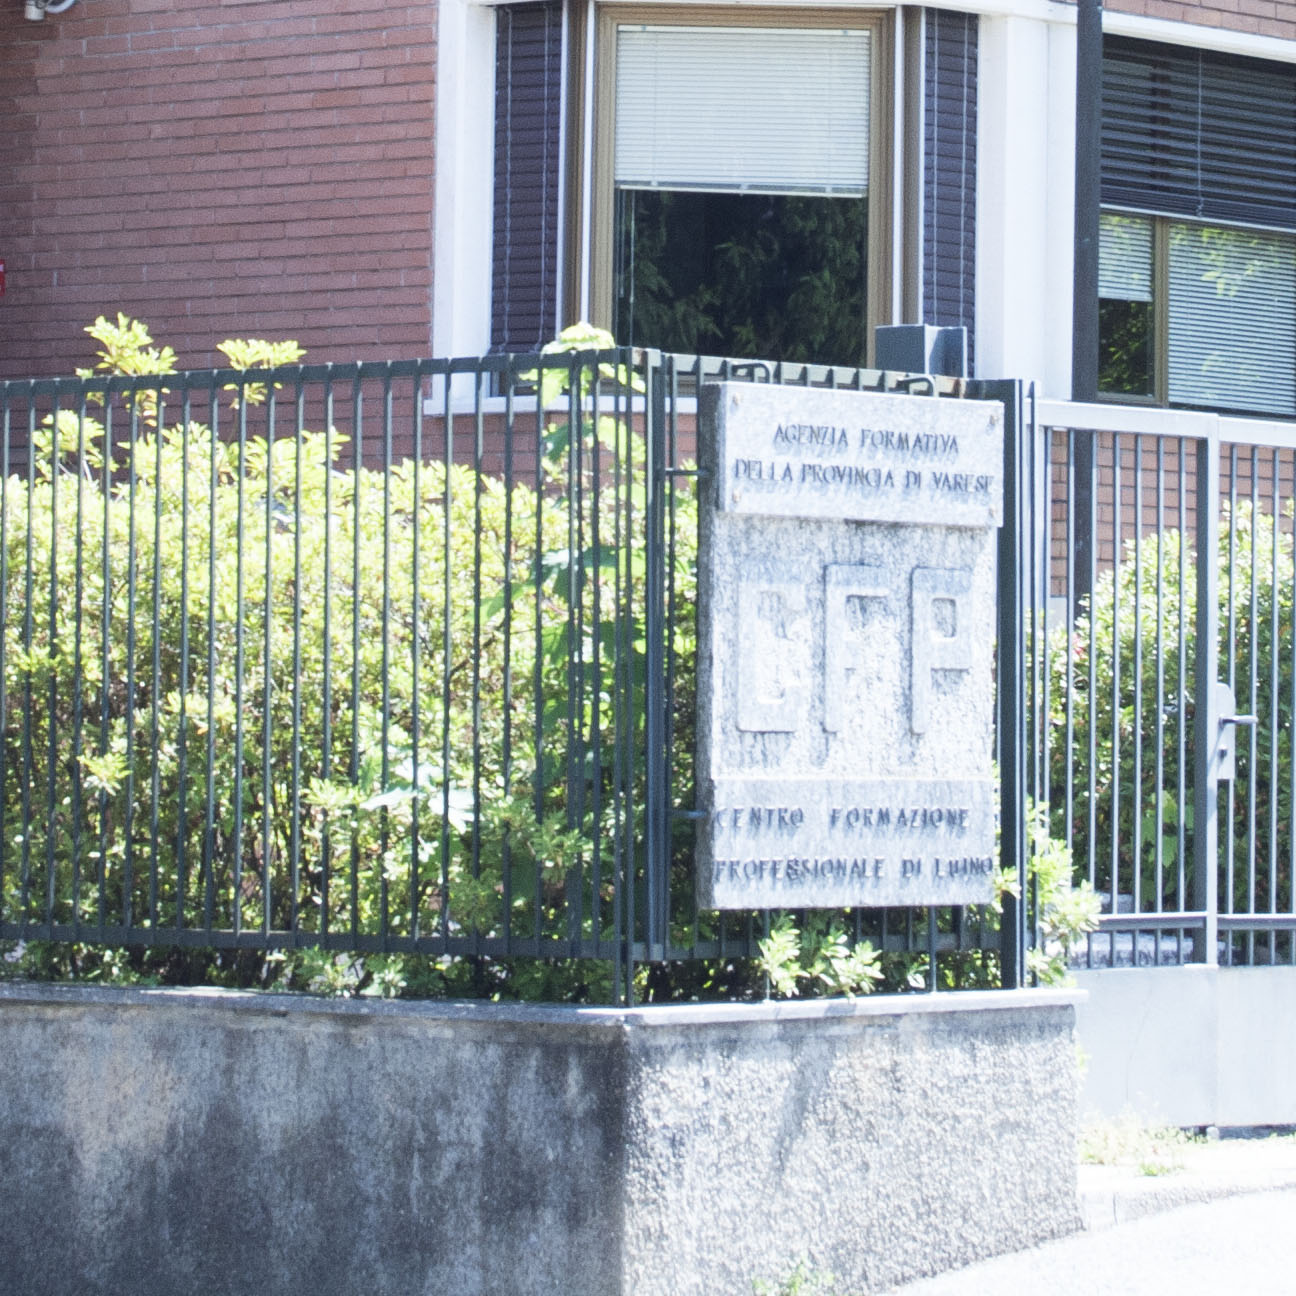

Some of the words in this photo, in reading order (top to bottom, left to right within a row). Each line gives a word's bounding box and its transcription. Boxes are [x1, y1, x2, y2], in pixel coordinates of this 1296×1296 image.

[773, 423, 849, 447] AGENZIA
[860, 428, 960, 454] FORMATIVA
[733, 458, 794, 483] DELLA
[800, 463, 895, 488] PROVINCIA
[905, 470, 922, 489] DI
[932, 471, 995, 493] VARESE
[715, 805, 805, 829] CENTRO
[829, 805, 971, 830] FORMAZIONE
[714, 856, 886, 882] PROFESSIONALE
[902, 857, 922, 879] DI
